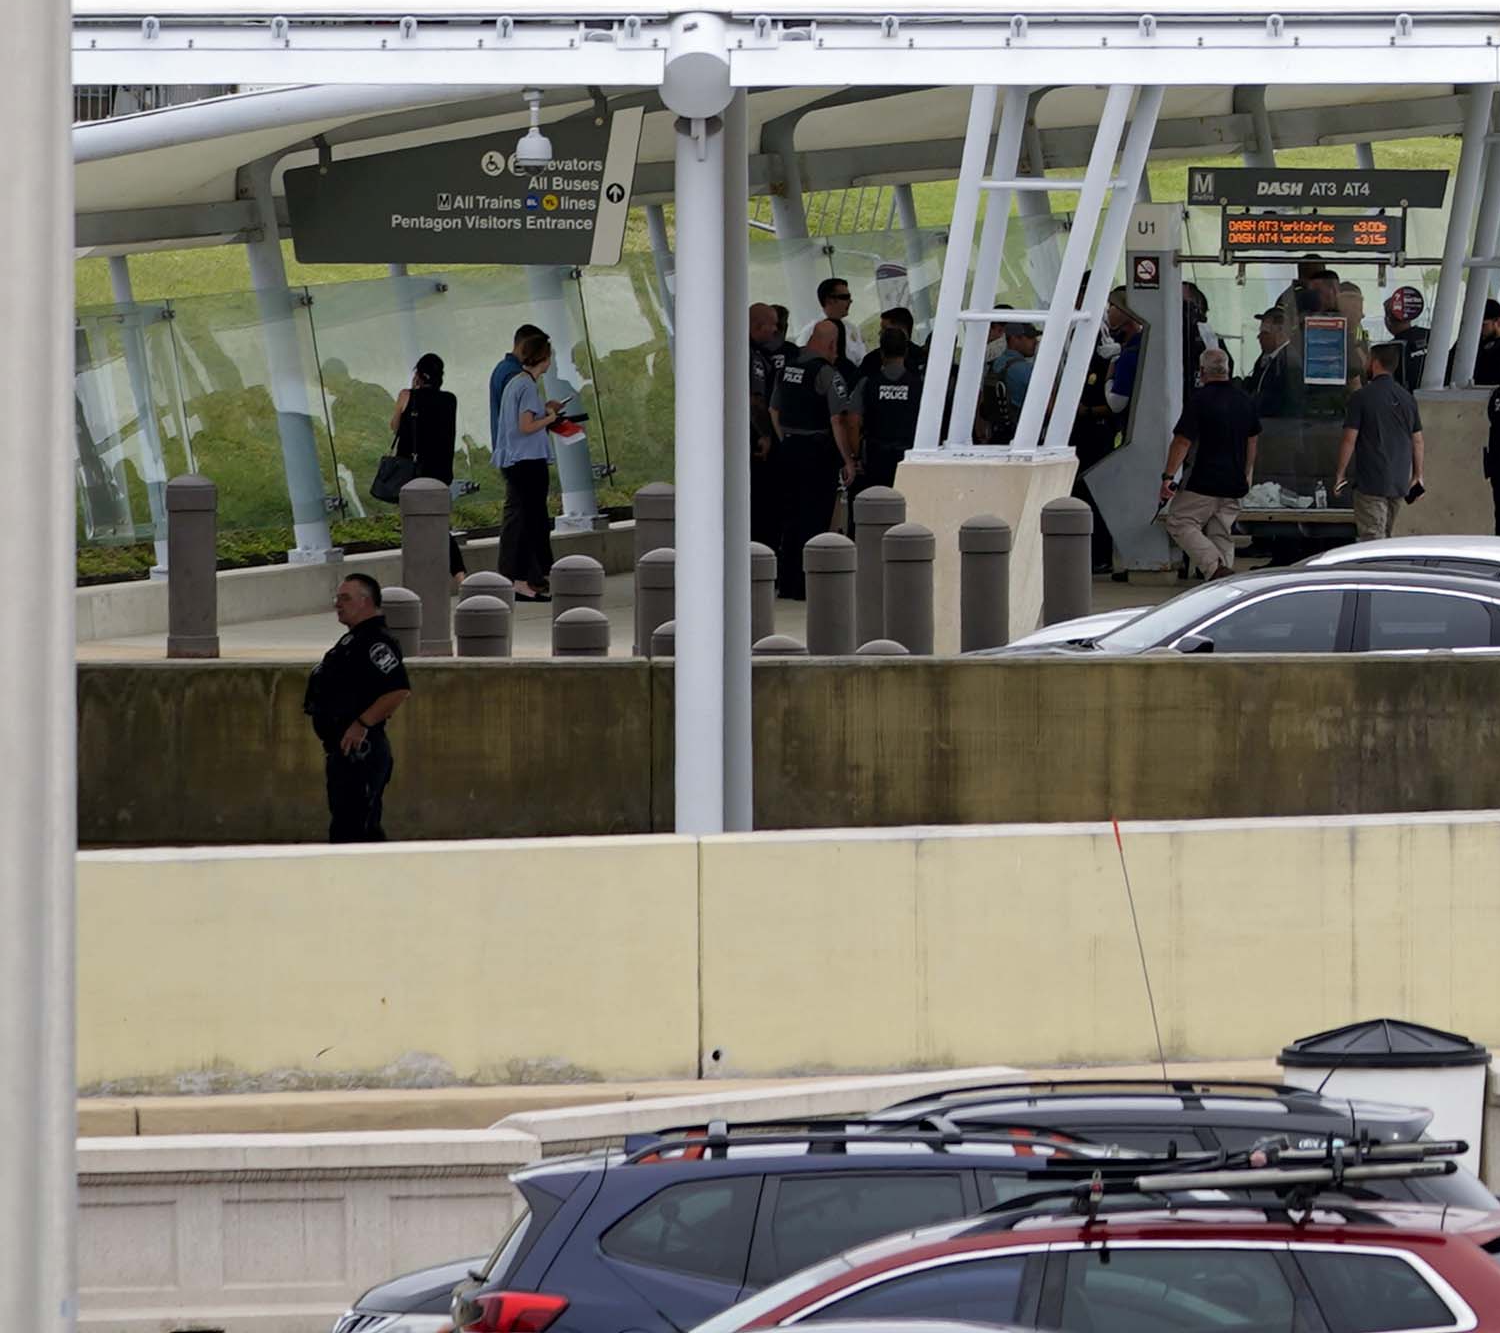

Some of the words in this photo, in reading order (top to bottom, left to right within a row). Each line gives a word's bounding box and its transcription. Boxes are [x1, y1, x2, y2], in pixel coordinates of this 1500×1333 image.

[547, 159, 603, 172] evators
[528, 176, 548, 190] All
[551, 176, 600, 191] Buses
[1194, 173, 1214, 194] M
[1256, 181, 1303, 196] DASH
[1310, 182, 1337, 196] AT3
[1343, 182, 1370, 196] AT4
[453, 195, 474, 210] All
[475, 195, 522, 210] Trains
[560, 194, 597, 211] lines
[391, 215, 462, 232] Pentagon
[464, 215, 522, 230] Visitors
[526, 215, 593, 230] Entrance
[1138, 221, 1155, 234] U1
[1228, 220, 1256, 232] DASH
[1257, 220, 1279, 232] AT3
[1280, 220, 1336, 232] arkfairfax
[1228, 232, 1256, 244] DASH
[1257, 232, 1279, 244] AT4
[1280, 232, 1336, 244] arkfairfax
[878, 391, 908, 400] POLICE
